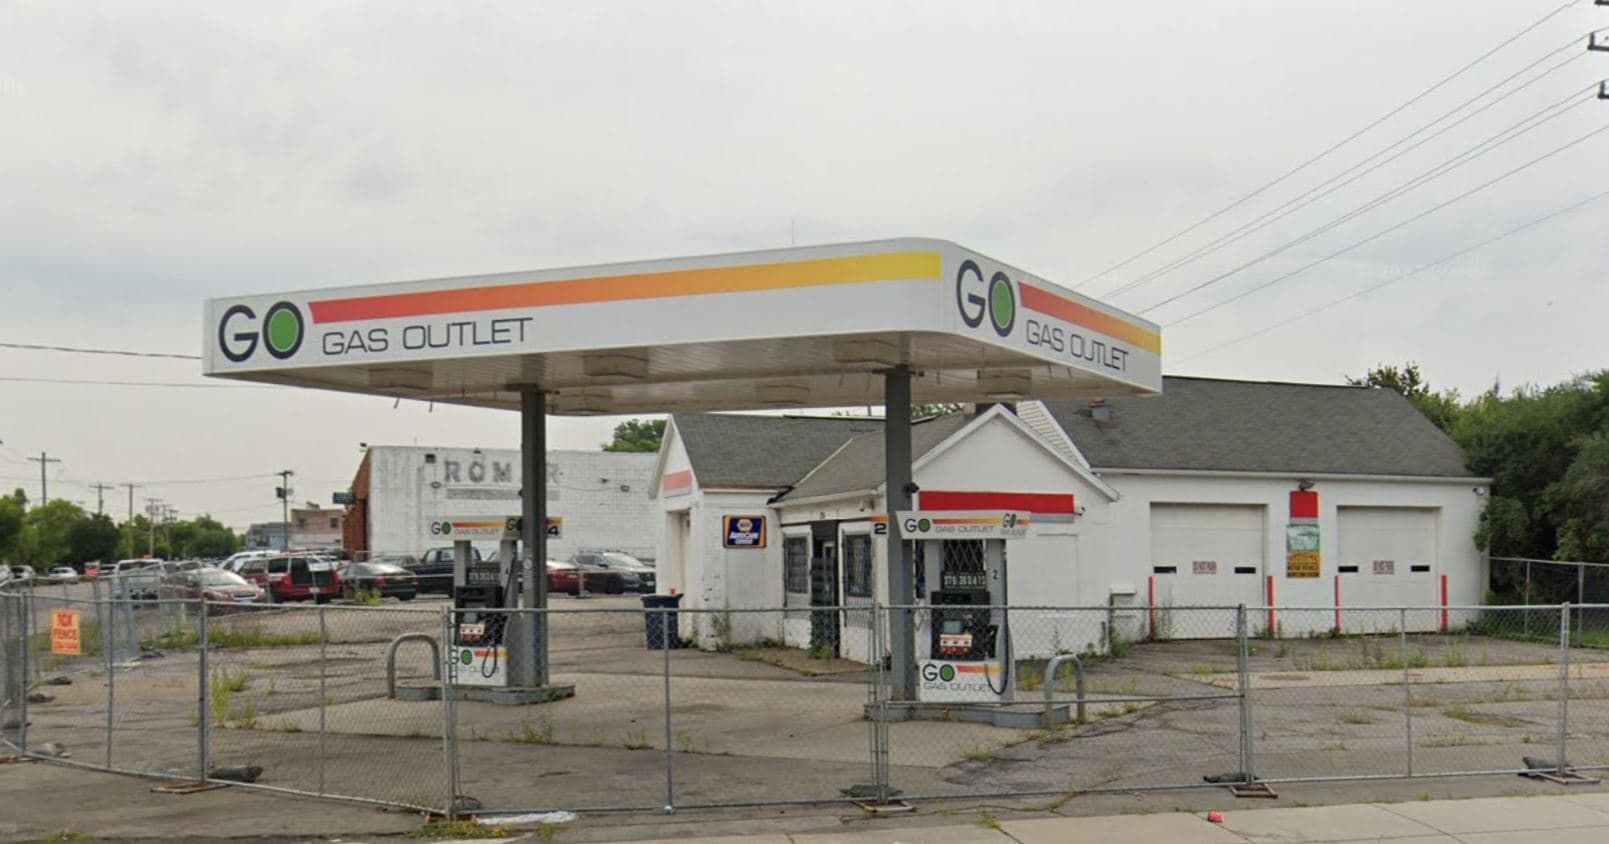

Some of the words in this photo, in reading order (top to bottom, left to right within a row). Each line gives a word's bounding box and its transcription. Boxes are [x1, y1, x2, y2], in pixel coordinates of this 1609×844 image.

[956, 259, 1016, 337] GO
[218, 301, 305, 362] GO
[322, 327, 389, 356] GAS
[402, 317, 533, 351] OUTLET
[1026, 319, 1065, 353] GAS
[1070, 333, 1129, 372] OUTLET
[444, 460, 562, 484] ROMR
[430, 521, 452, 535] GO
[547, 525, 560, 537] 4
[873, 522, 887, 535] 2
[904, 518, 931, 533] GO
[935, 525, 955, 534] GAS
[957, 525, 994, 534] OUTLET
[992, 569, 999, 580] 2
[922, 663, 955, 682] GO
[923, 681, 947, 691] GAS
